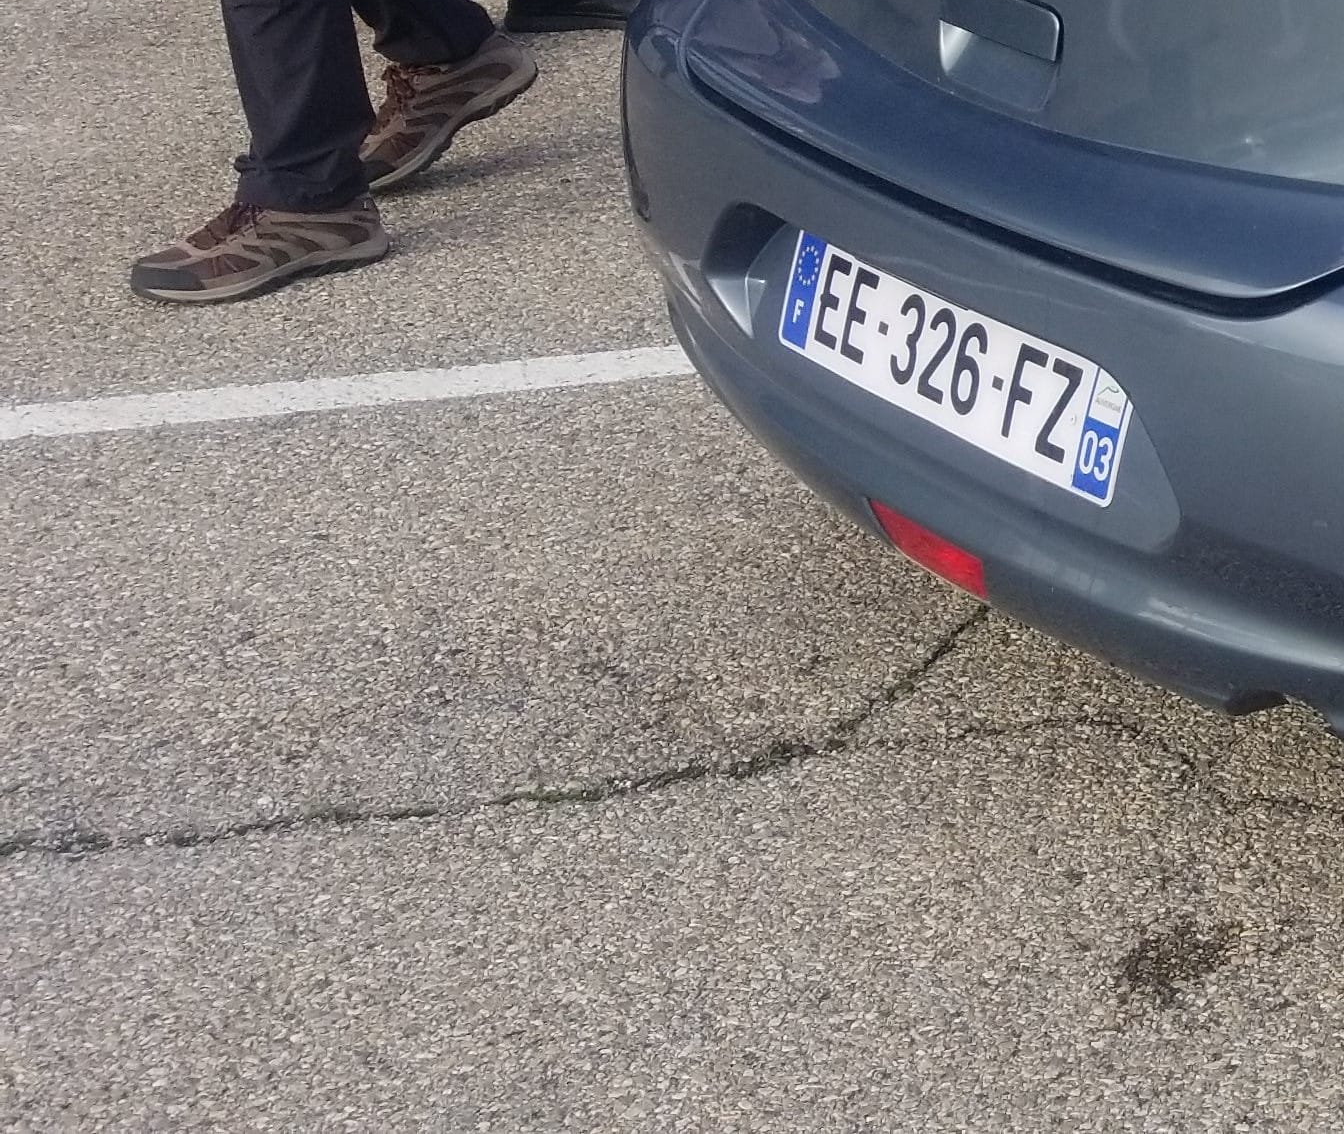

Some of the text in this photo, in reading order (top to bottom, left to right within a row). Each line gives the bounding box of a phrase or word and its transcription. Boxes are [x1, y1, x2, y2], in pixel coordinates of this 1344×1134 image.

[792, 298, 805, 324] F
[813, 253, 1083, 464] EE-326-FZ
[1079, 430, 1114, 481] 03
